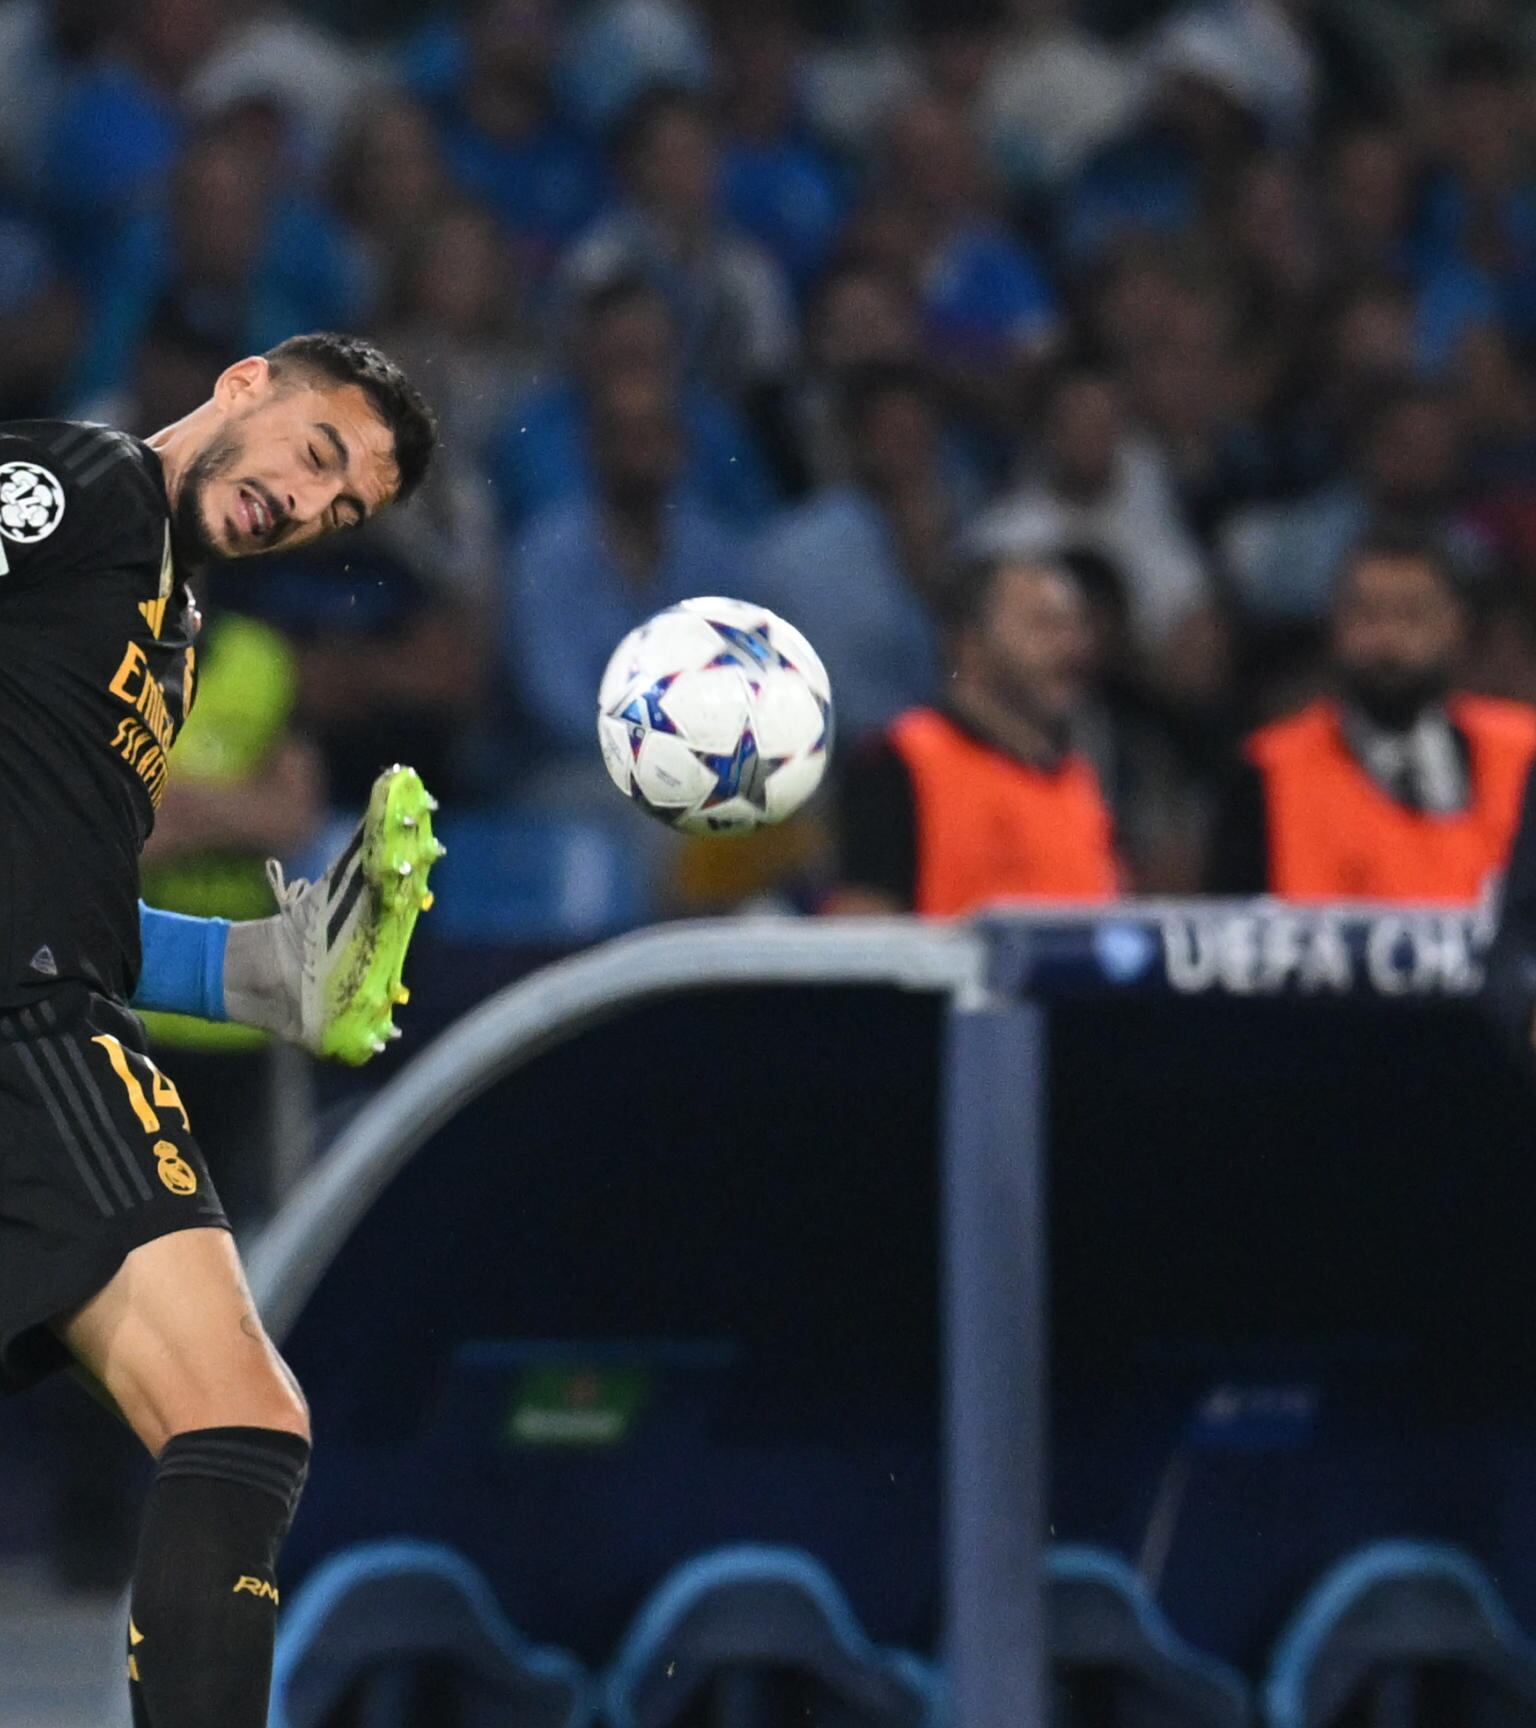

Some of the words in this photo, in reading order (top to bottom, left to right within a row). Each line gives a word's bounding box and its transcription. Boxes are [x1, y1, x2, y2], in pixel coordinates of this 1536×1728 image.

[1163, 910, 1354, 994] UEFA
[91, 1034, 190, 1134] 14
[233, 1575, 279, 1606] RM
